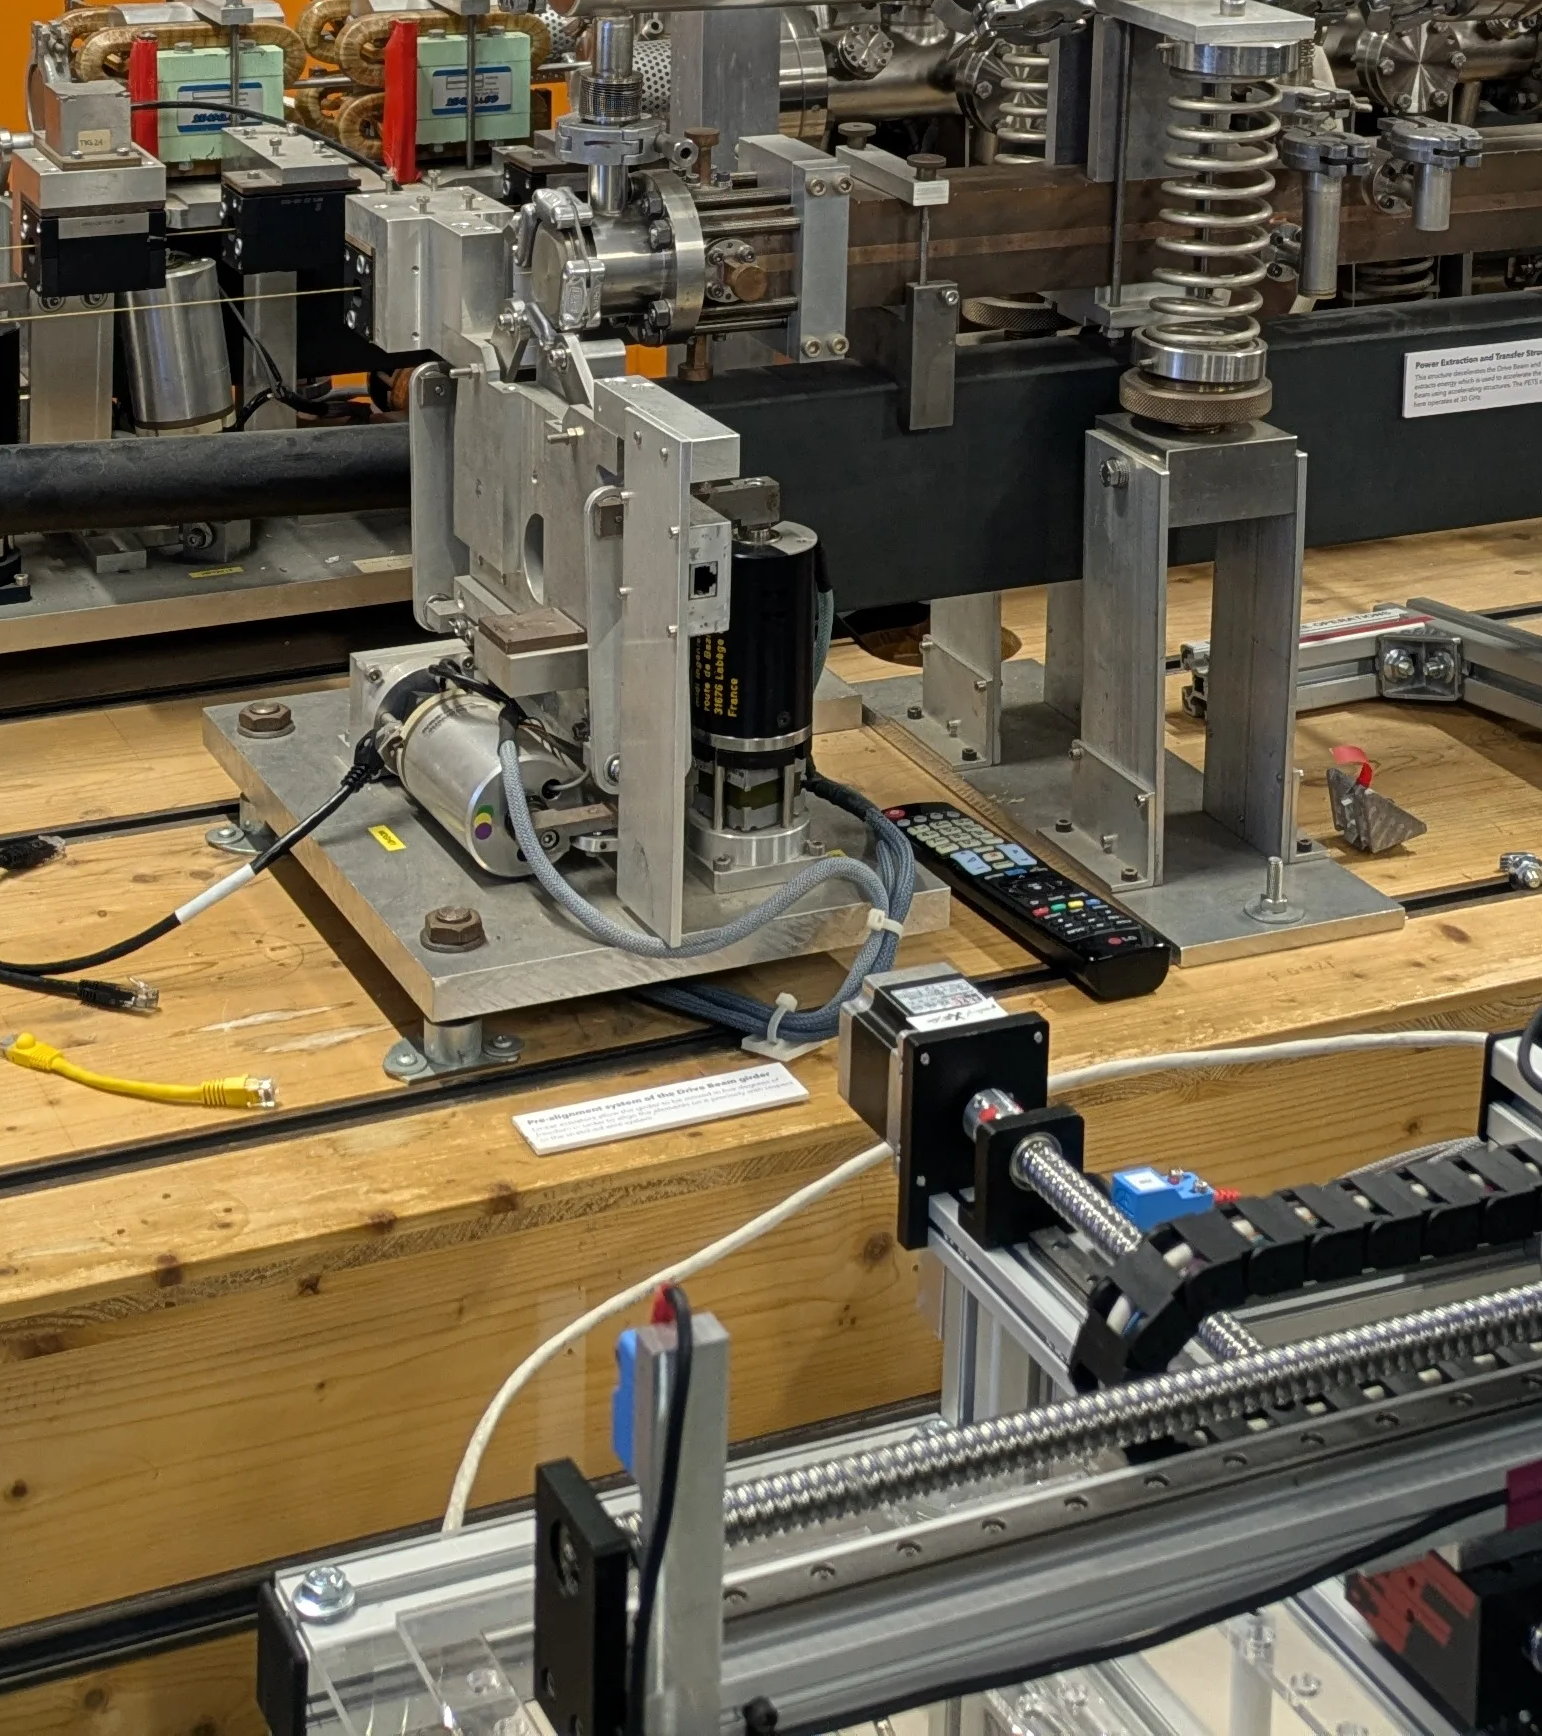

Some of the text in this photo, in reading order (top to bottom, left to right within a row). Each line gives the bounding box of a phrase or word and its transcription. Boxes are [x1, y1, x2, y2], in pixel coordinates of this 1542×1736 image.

[1415, 359, 1439, 369] Power
[1440, 355, 1478, 366] Extraction
[1494, 349, 1524, 360] Transfer
[703, 664, 711, 678] de
[714, 684, 723, 715] 31676
[728, 677, 738, 717] France
[527, 1107, 604, 1125] Pre-alignment
[604, 1099, 645, 1110] system
[676, 1085, 707, 1094] Drive
[706, 1078, 738, 1088] Beam
[737, 1071, 773, 1082] girder
